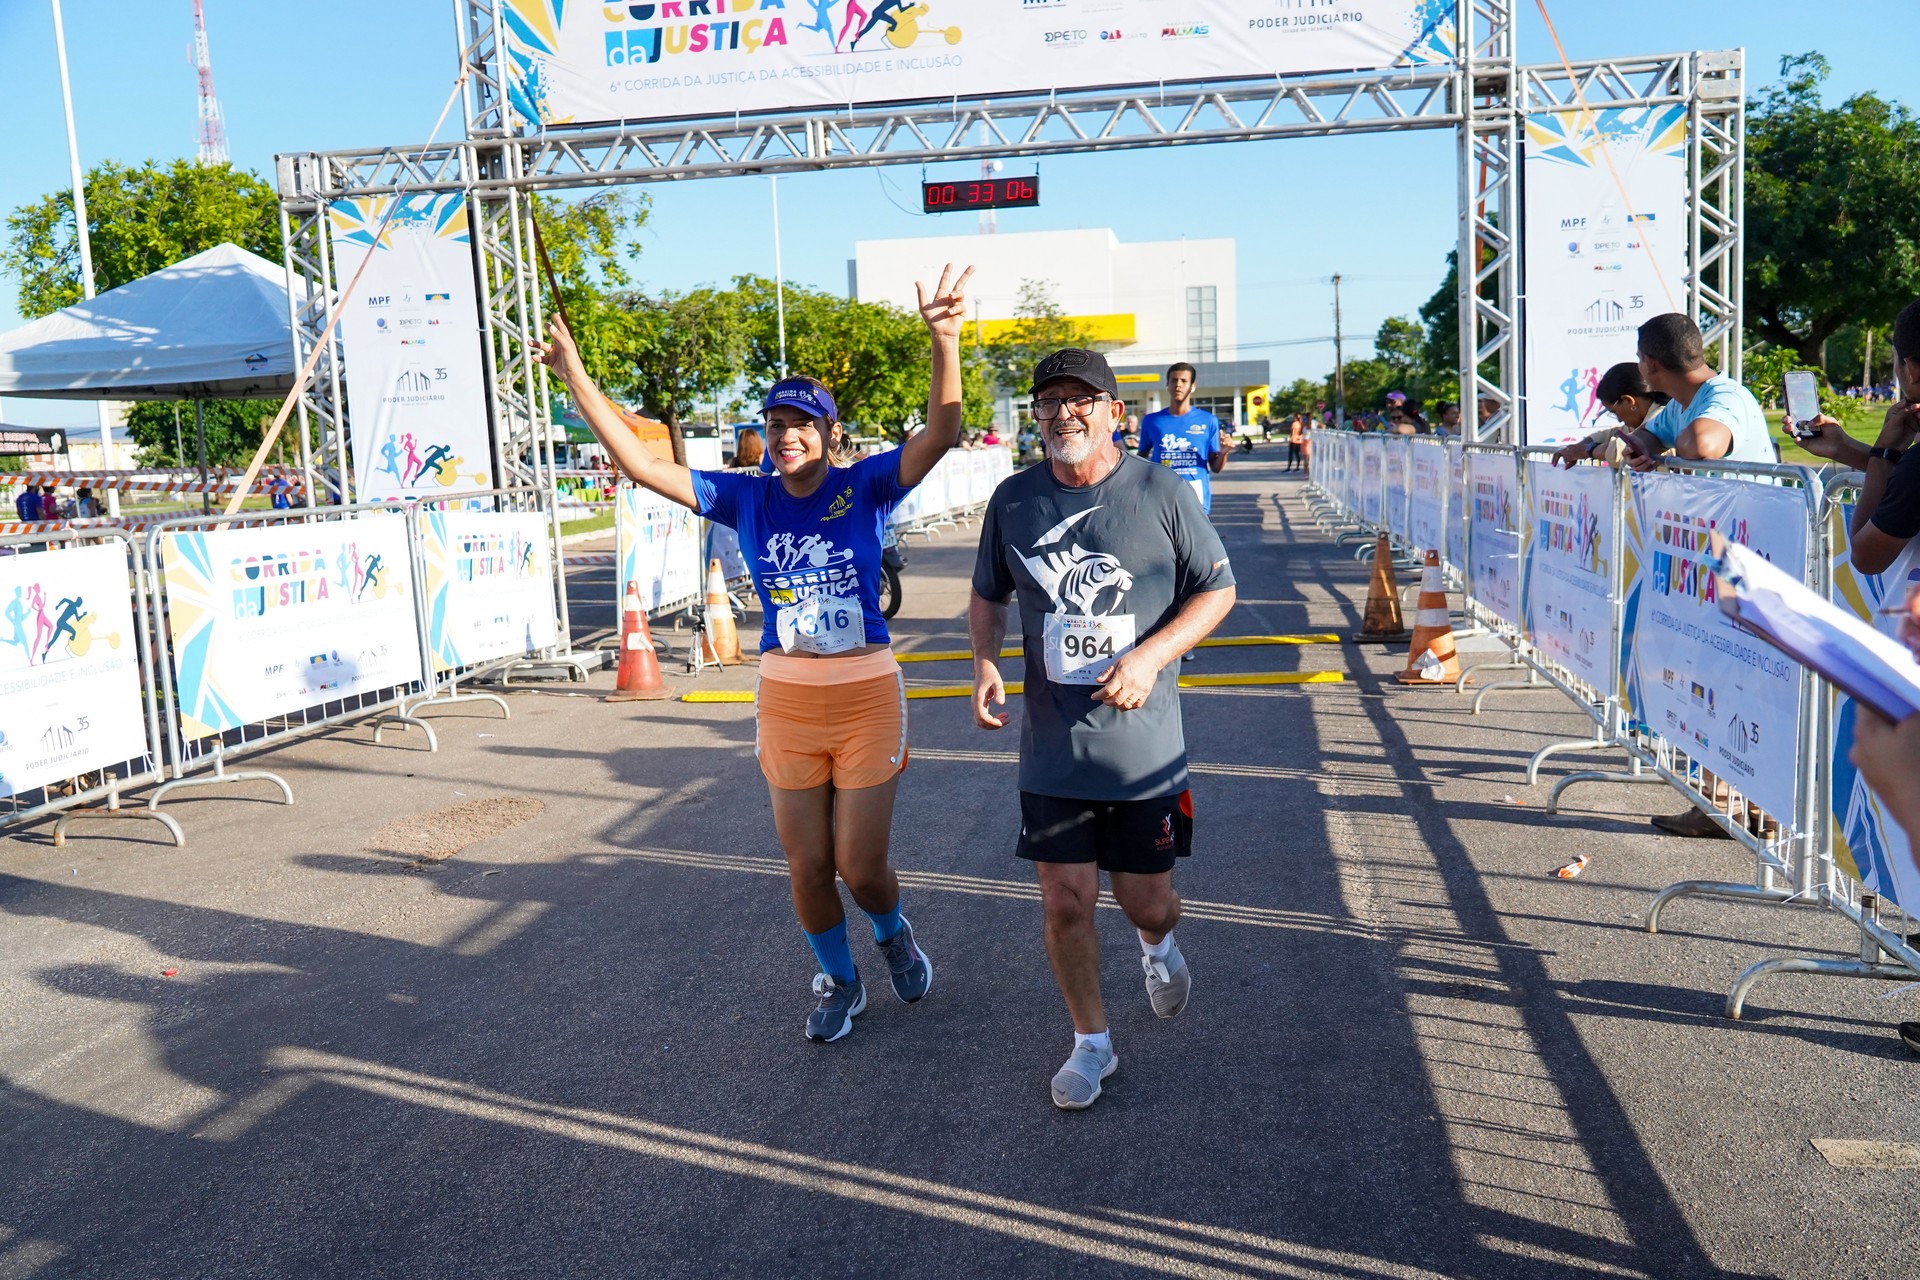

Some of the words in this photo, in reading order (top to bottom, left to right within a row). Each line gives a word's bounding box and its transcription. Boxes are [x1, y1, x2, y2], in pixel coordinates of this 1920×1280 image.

[1161, 25, 1209, 37] PALMAS
[1249, 17, 1289, 29] PODER
[1293, 11, 1363, 27] JUDICIÁRIO
[606, 31, 648, 67] da
[648, 18, 787, 63] JUSTIÇA
[625, 77, 680, 91] CORRIDA
[684, 75, 702, 86] DA
[706, 70, 756, 86] JUSTIÇA
[760, 69, 778, 80] DA
[782, 61, 881, 79] ACESSIBILIDADE
[886, 60, 893, 71] E
[897, 54, 963, 71] INCLUSÃO
[927, 185, 954, 205] 00
[968, 183, 994, 203] 33
[1006, 181, 1033, 200] 06
[1561, 218, 1586, 228] MPF
[368, 296, 391, 305] MPF
[1629, 296, 1644, 309] 35
[434, 368, 447, 380] 35
[407, 394, 445, 402] JUDICIÁRIO
[230, 549, 326, 581] CORRIDA
[762, 562, 859, 590] CORRIDA
[791, 576, 860, 605] JUSTIÇA
[1665, 554, 1715, 606] JUSTIÇA
[258, 577, 329, 616] JUSTIÇA
[789, 608, 849, 635] 1316
[1064, 634, 1115, 658] 964
[265, 664, 283, 676] MPF
[77, 716, 90, 731] 35
[1750, 721, 1759, 744] 35
[26, 758, 48, 771] PODER
[1719, 746, 1732, 762] PODER
[1732, 753, 1755, 776] JUDICIÁRIO
